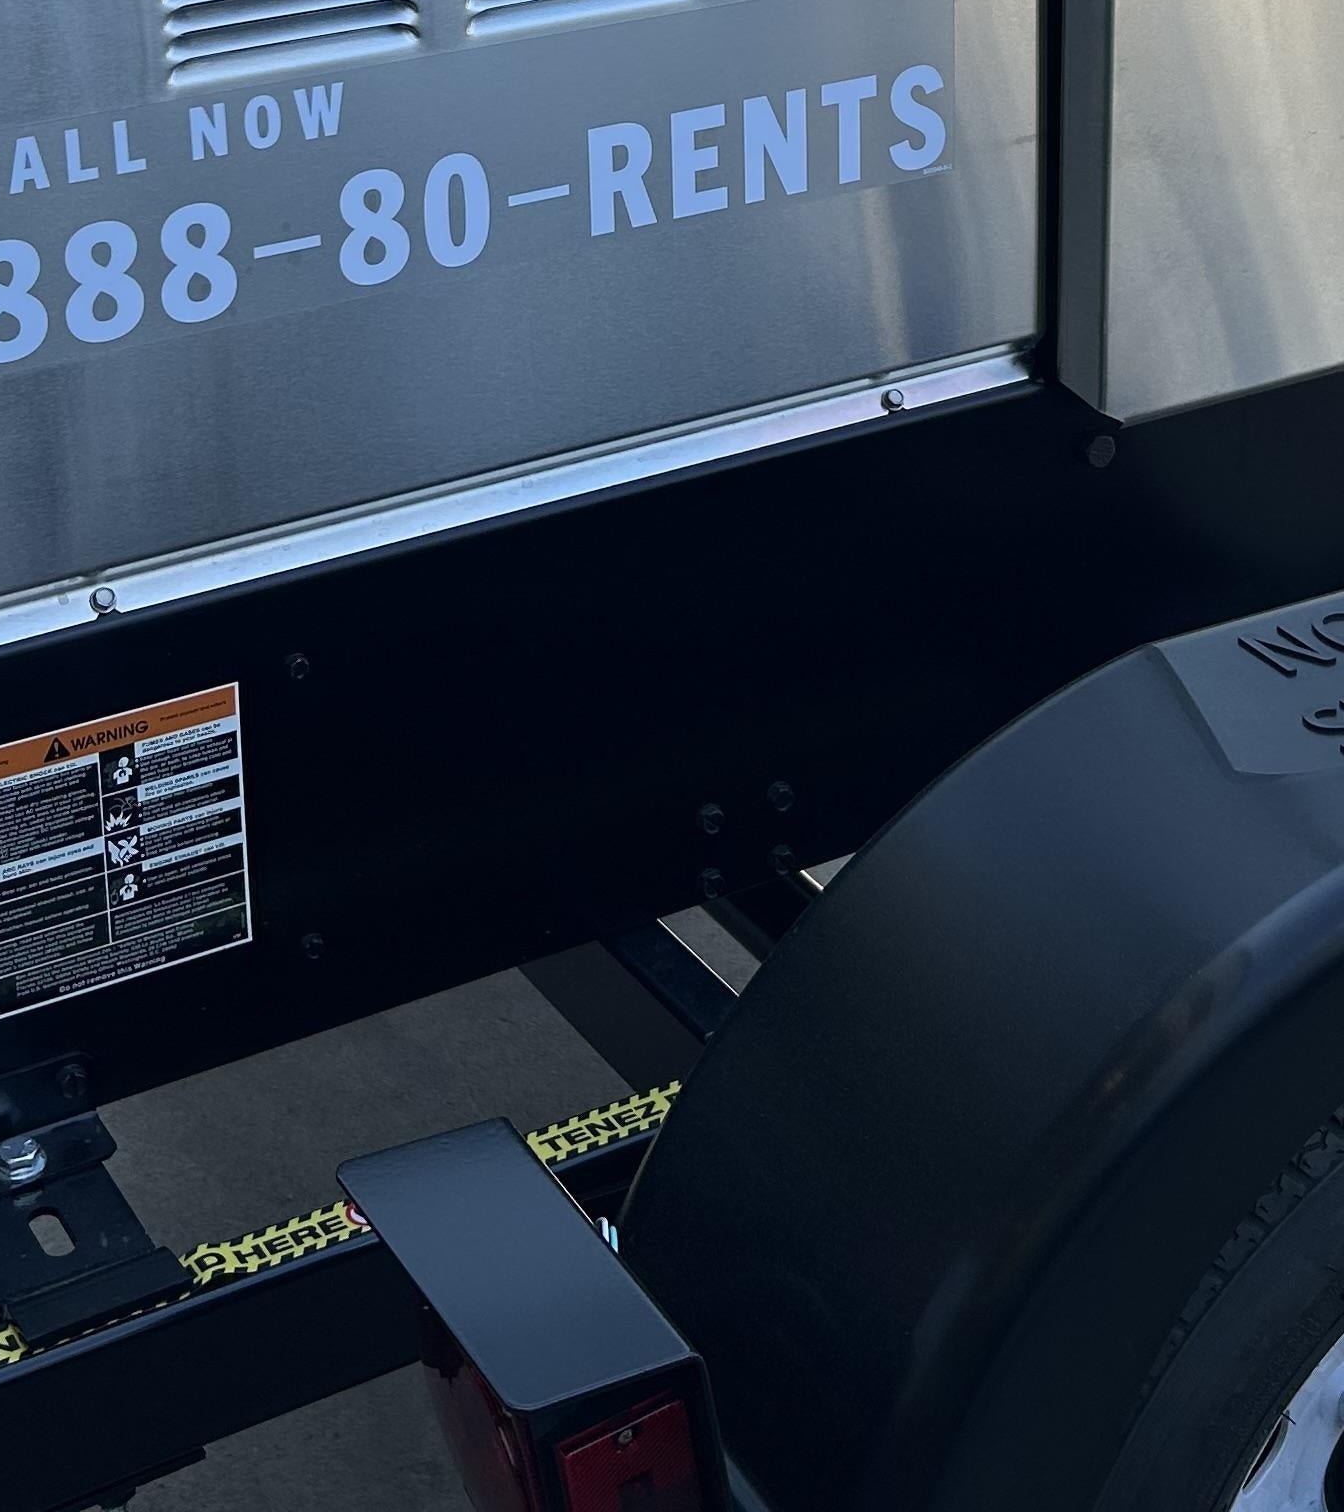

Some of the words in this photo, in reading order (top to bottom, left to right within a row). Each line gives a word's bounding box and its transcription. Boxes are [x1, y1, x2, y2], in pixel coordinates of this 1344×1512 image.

[189, 81, 344, 162] NOW
[70, 719, 150, 752] WARNING
[541, 1099, 662, 1151] TENEZ
[194, 1250, 226, 1272] D
[234, 1215, 348, 1264] HERE
